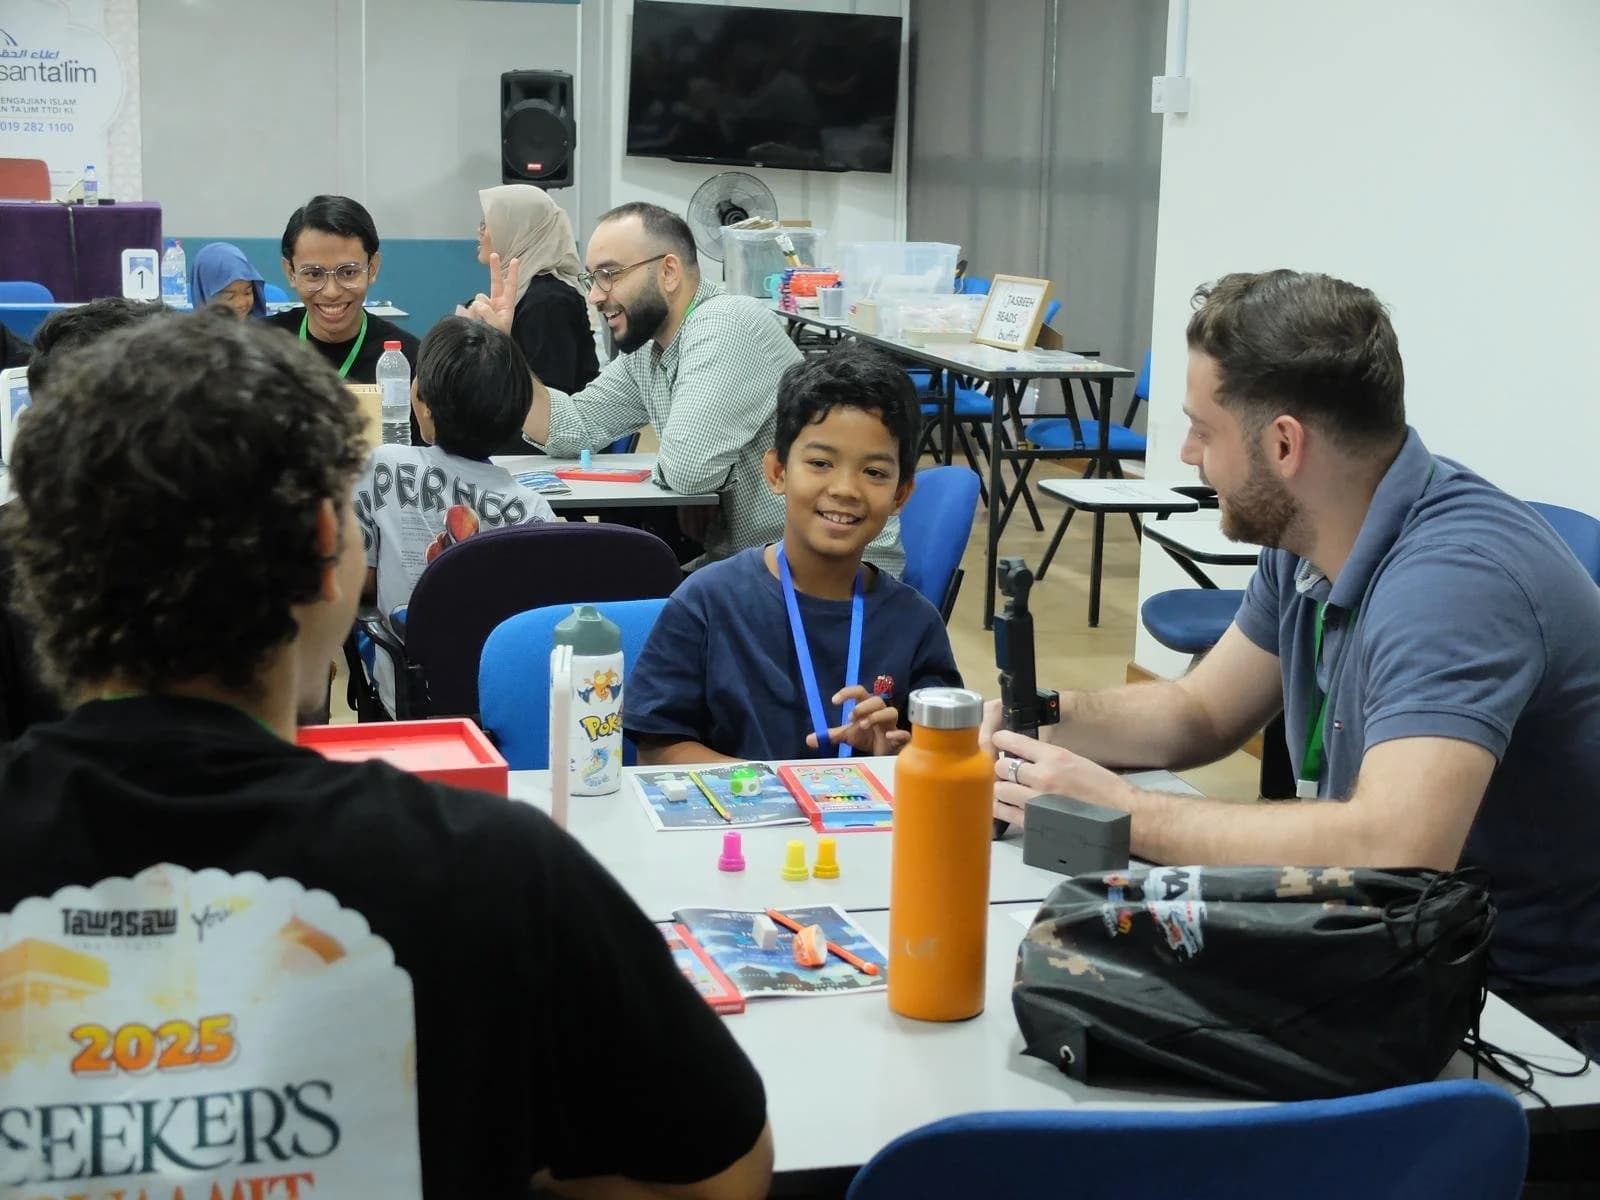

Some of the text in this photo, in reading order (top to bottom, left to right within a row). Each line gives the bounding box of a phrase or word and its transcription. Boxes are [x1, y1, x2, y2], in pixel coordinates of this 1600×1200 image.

[49, 98, 77, 106] ISLAM
[0, 121, 74, 133] 019 282 1100
[137, 270, 144, 289] 1
[353, 462, 448, 551] UPER
[579, 704, 623, 742] Pok
[70, 1014, 236, 1075] 2025
